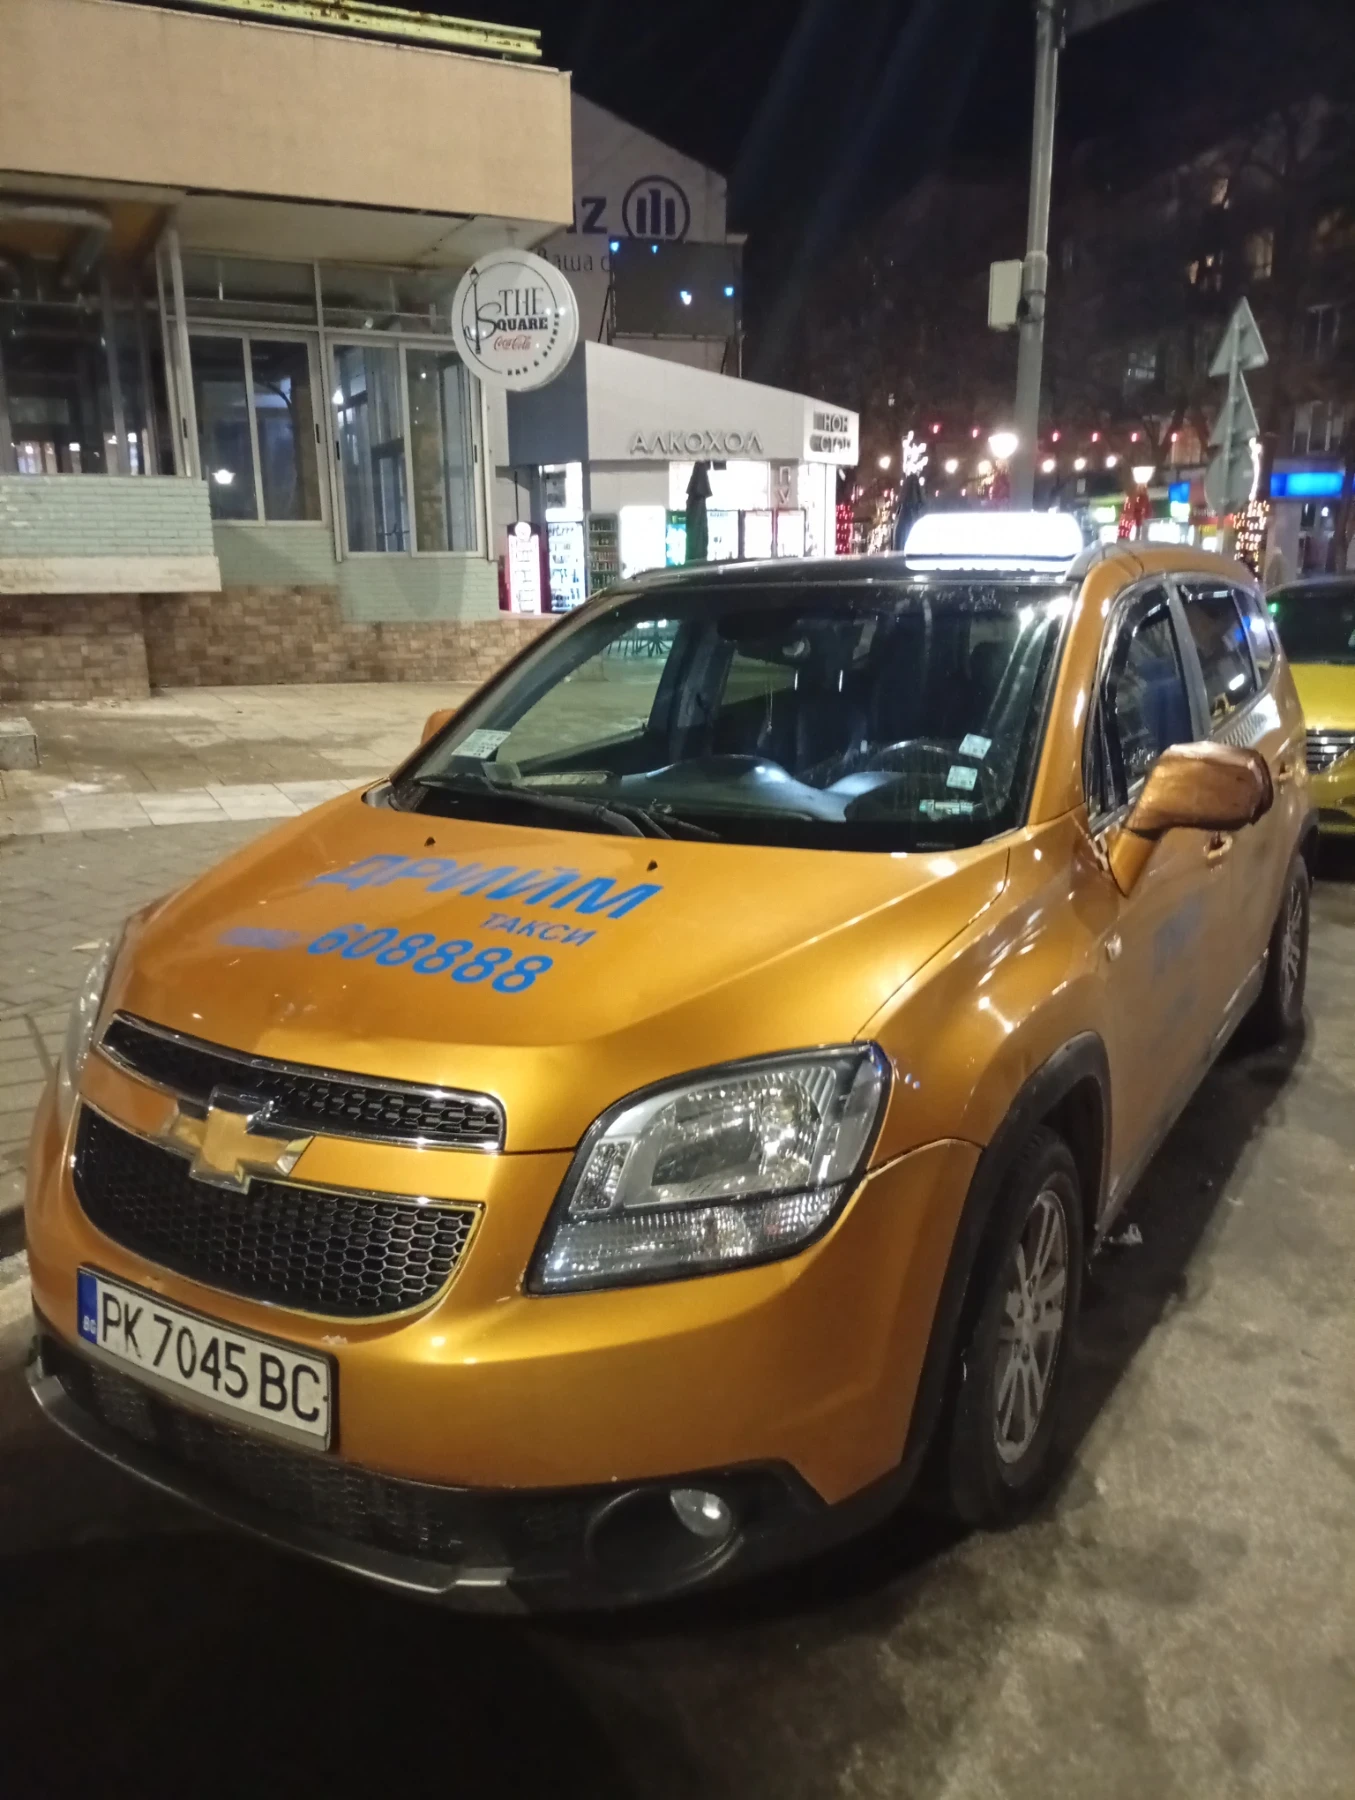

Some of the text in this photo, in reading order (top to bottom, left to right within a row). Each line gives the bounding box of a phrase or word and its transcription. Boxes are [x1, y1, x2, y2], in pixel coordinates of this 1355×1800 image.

[566, 196, 607, 234] z
[498, 287, 544, 317] THE
[463, 301, 549, 342] SQUARE
[493, 334, 533, 352] CocaCola
[629, 430, 764, 455] АЛКОХОЛ
[480, 912, 598, 947] ТАКСИ
[306, 922, 555, 994] 608888
[82, 1315, 98, 1335] BG
